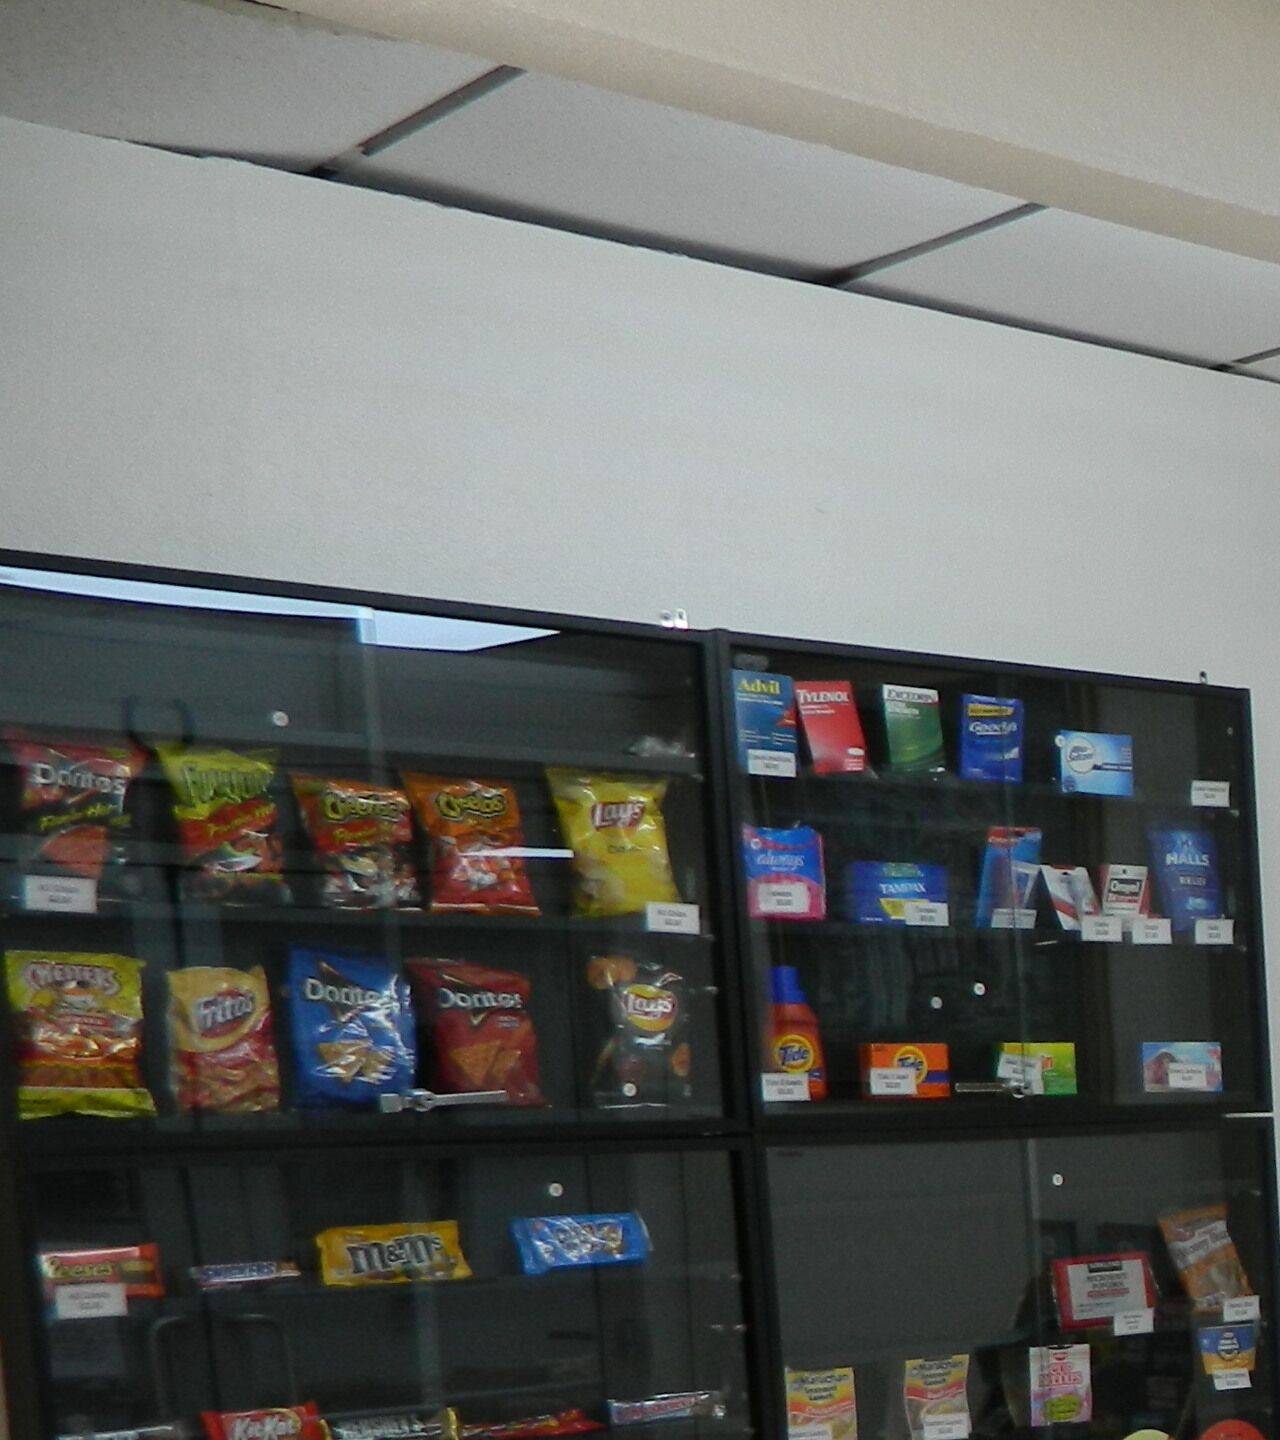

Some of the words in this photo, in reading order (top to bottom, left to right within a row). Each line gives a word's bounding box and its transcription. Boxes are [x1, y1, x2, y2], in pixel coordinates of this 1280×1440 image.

[739, 679, 780, 694] Advil
[31, 763, 126, 795] Doritos
[1165, 853, 1210, 866] HALLS
[778, 1043, 812, 1066] Tide
